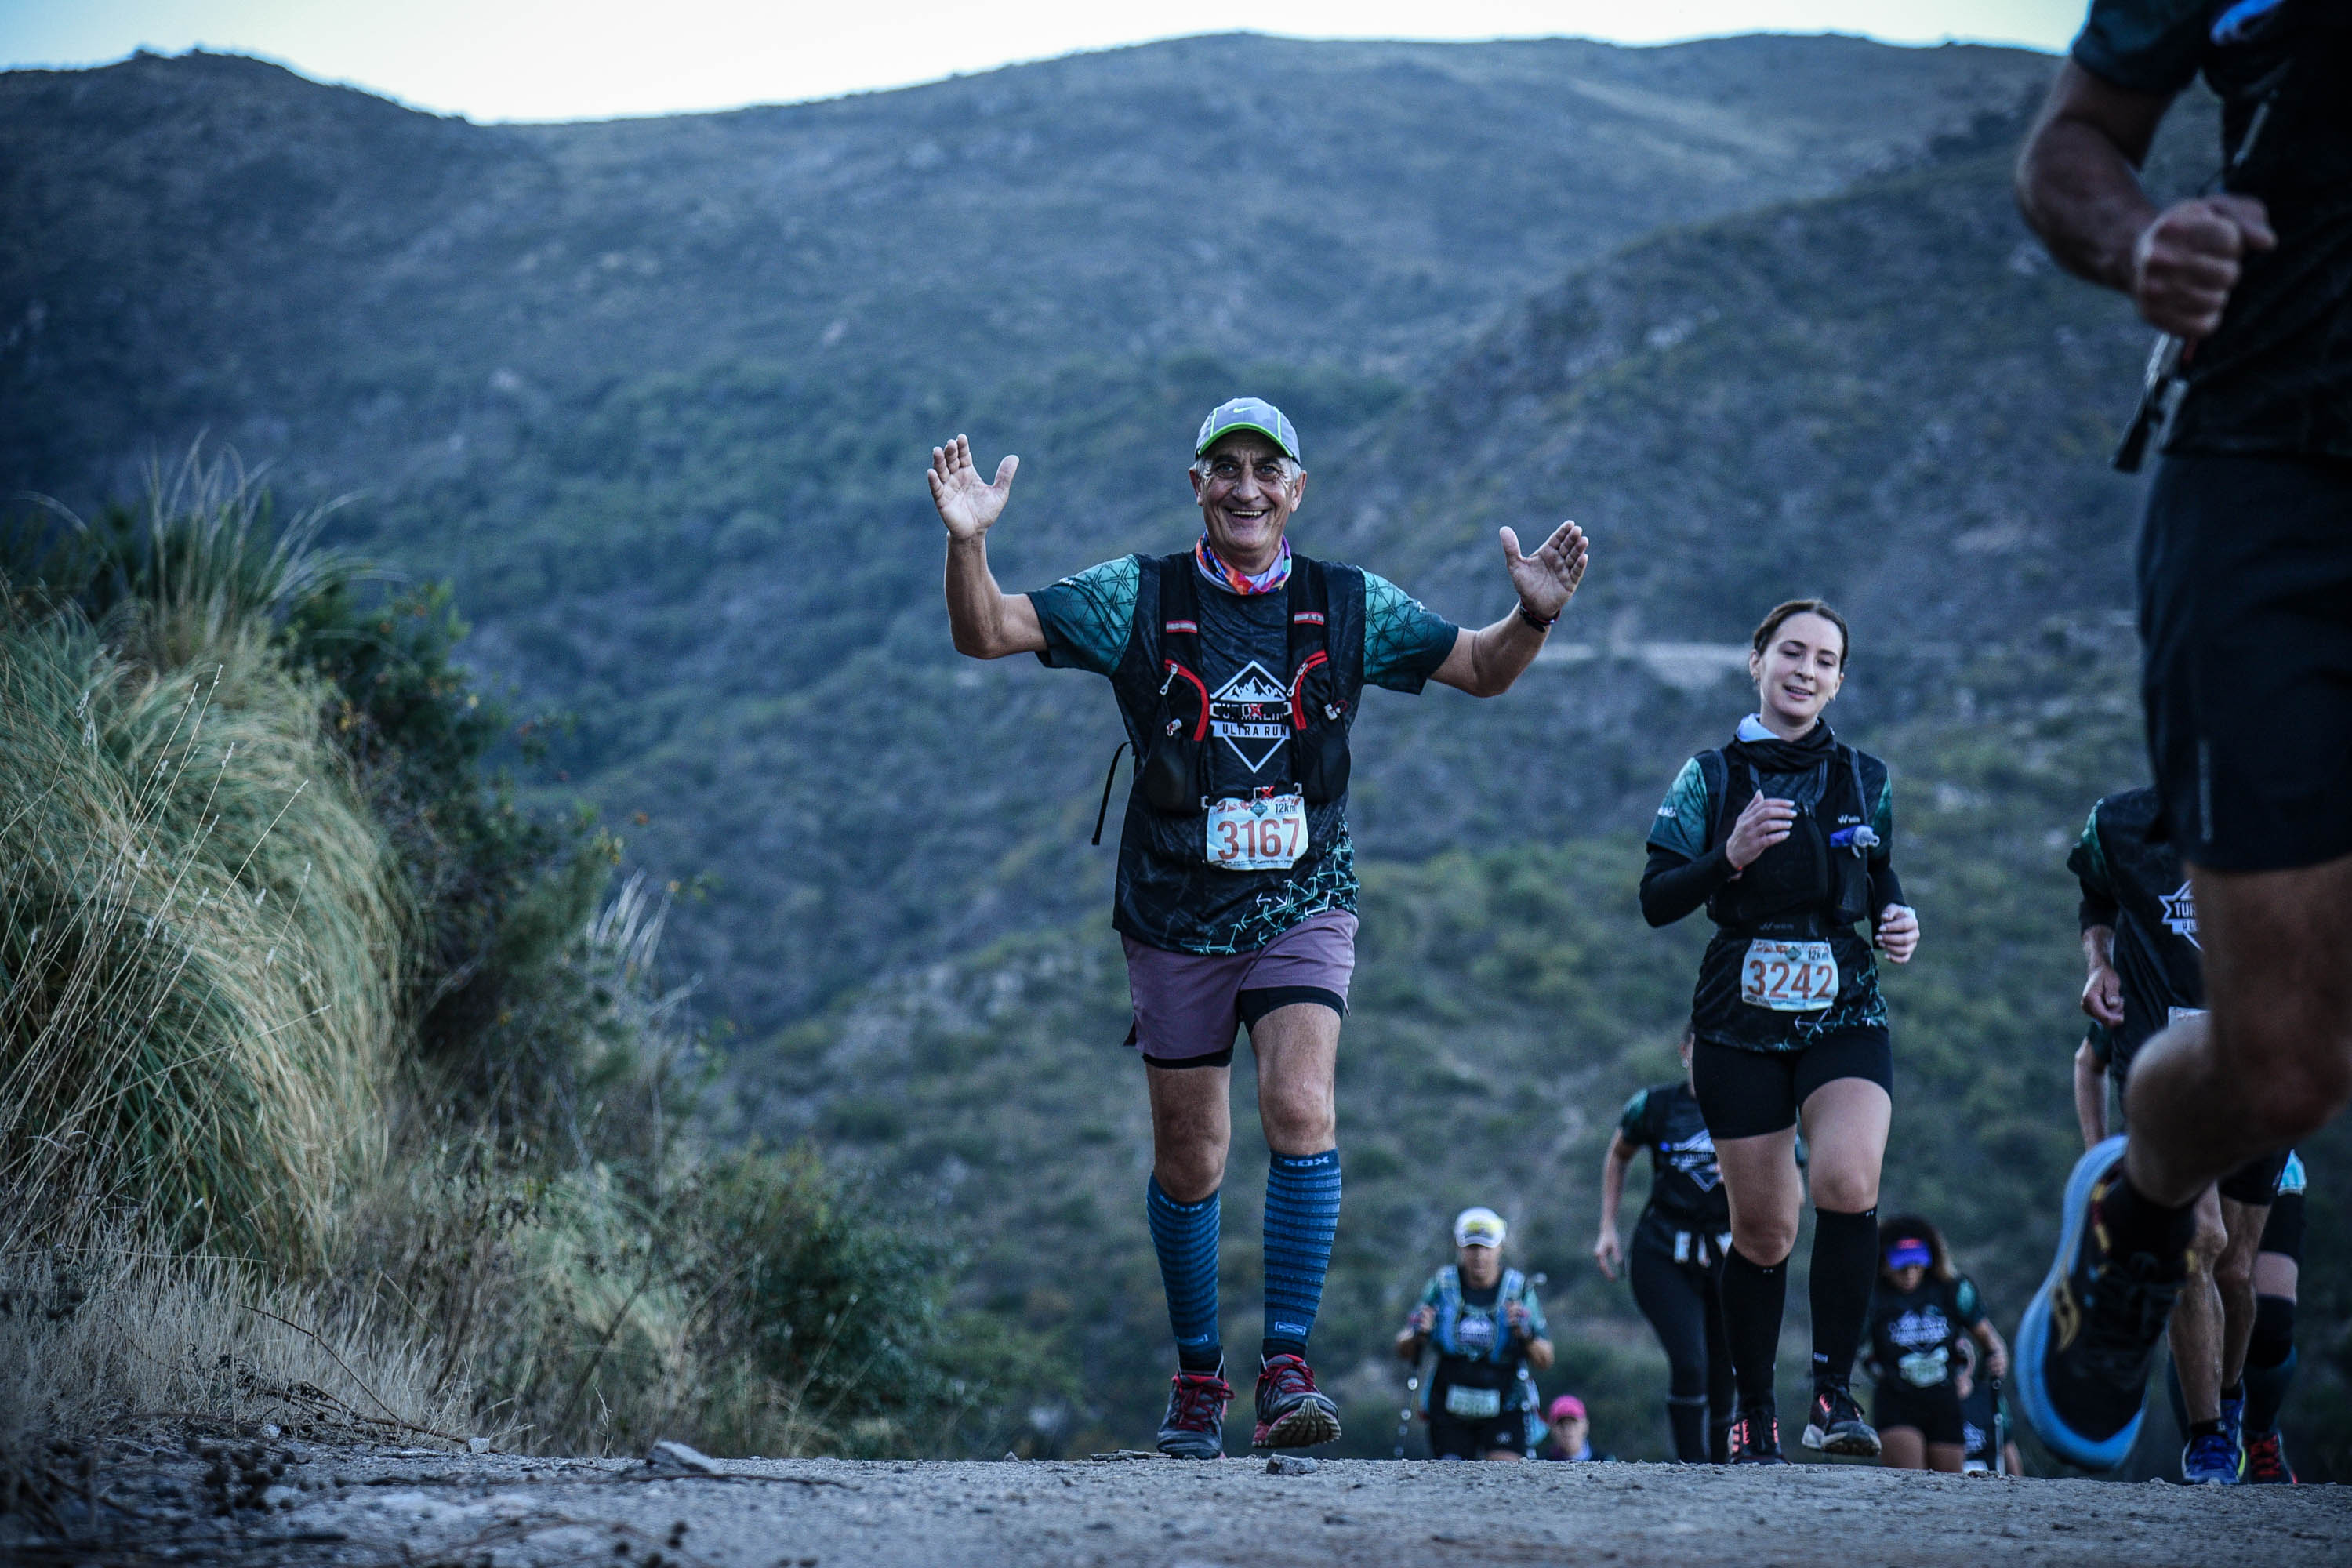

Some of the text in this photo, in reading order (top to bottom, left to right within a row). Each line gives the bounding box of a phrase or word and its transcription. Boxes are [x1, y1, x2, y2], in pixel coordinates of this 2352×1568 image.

[1223, 723, 1287, 737] ULTRA RUN
[1275, 802, 1297, 814] 12km
[1217, 818, 1300, 860] 3167
[1748, 960, 1833, 1000] 3242
